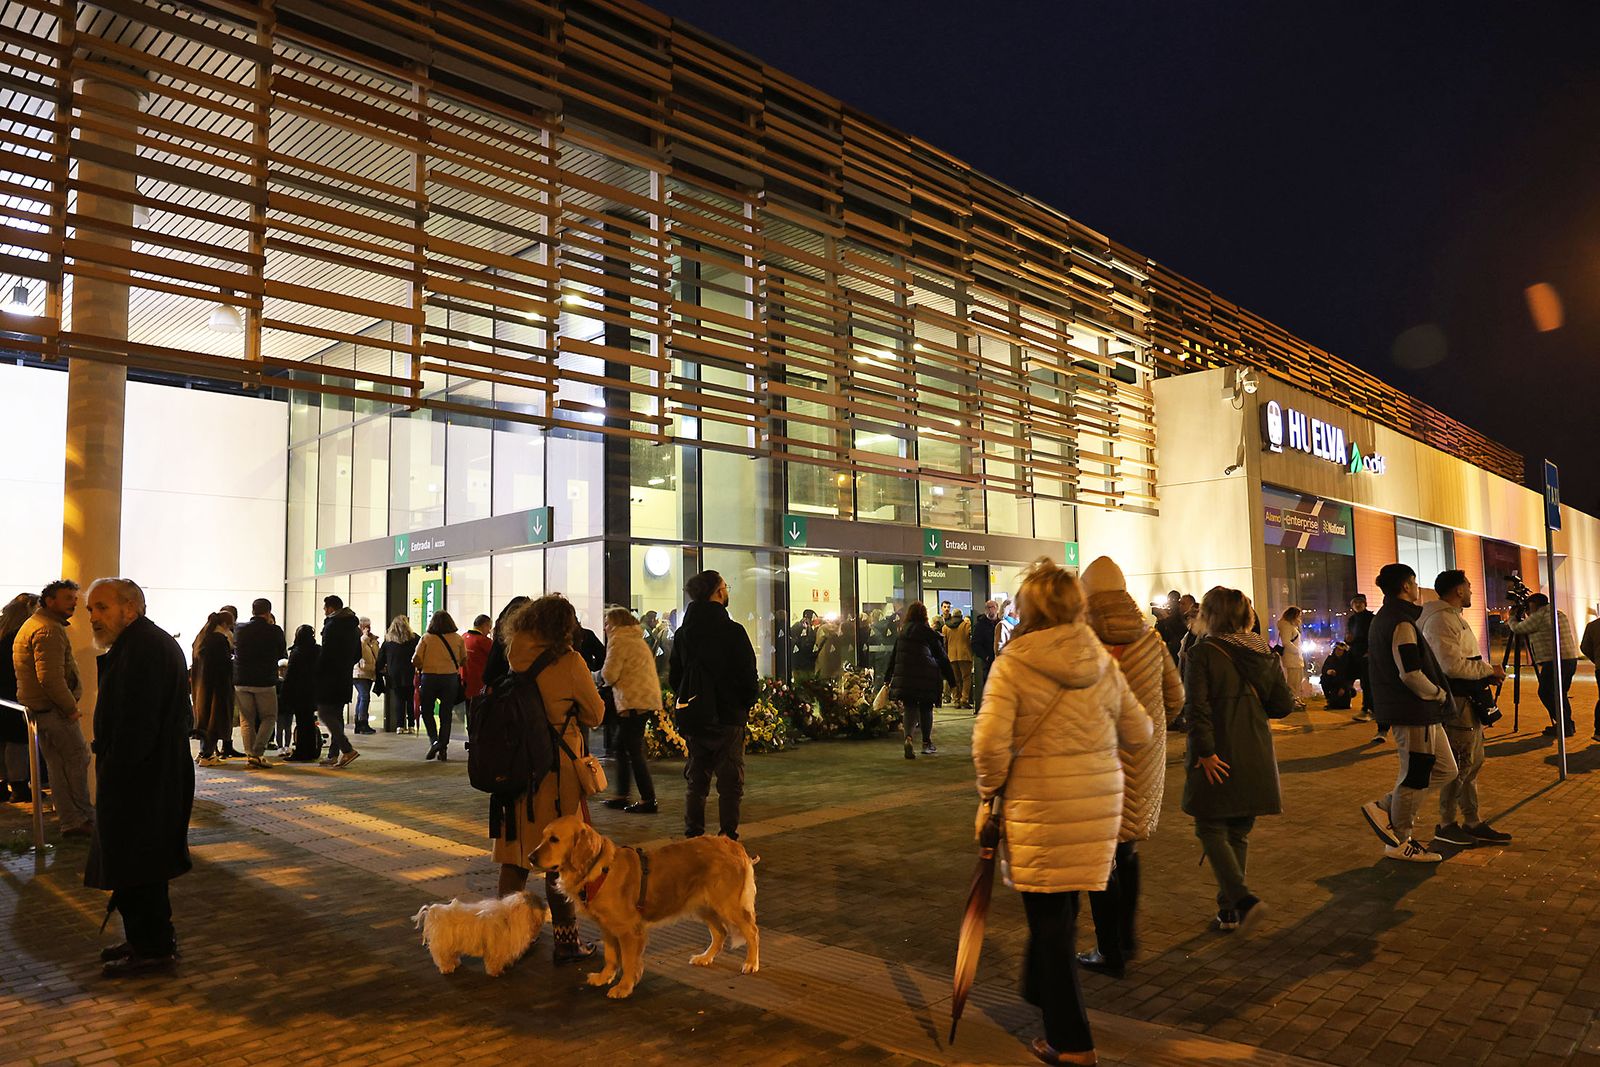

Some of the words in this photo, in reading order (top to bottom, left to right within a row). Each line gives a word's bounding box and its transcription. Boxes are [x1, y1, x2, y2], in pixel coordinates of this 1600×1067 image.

[1287, 408, 1348, 466] HUELVA
[1285, 514, 1319, 530] enterprise
[1328, 522, 1346, 535] National
[411, 540, 431, 552] Entrada
[945, 540, 967, 550] Entrada
